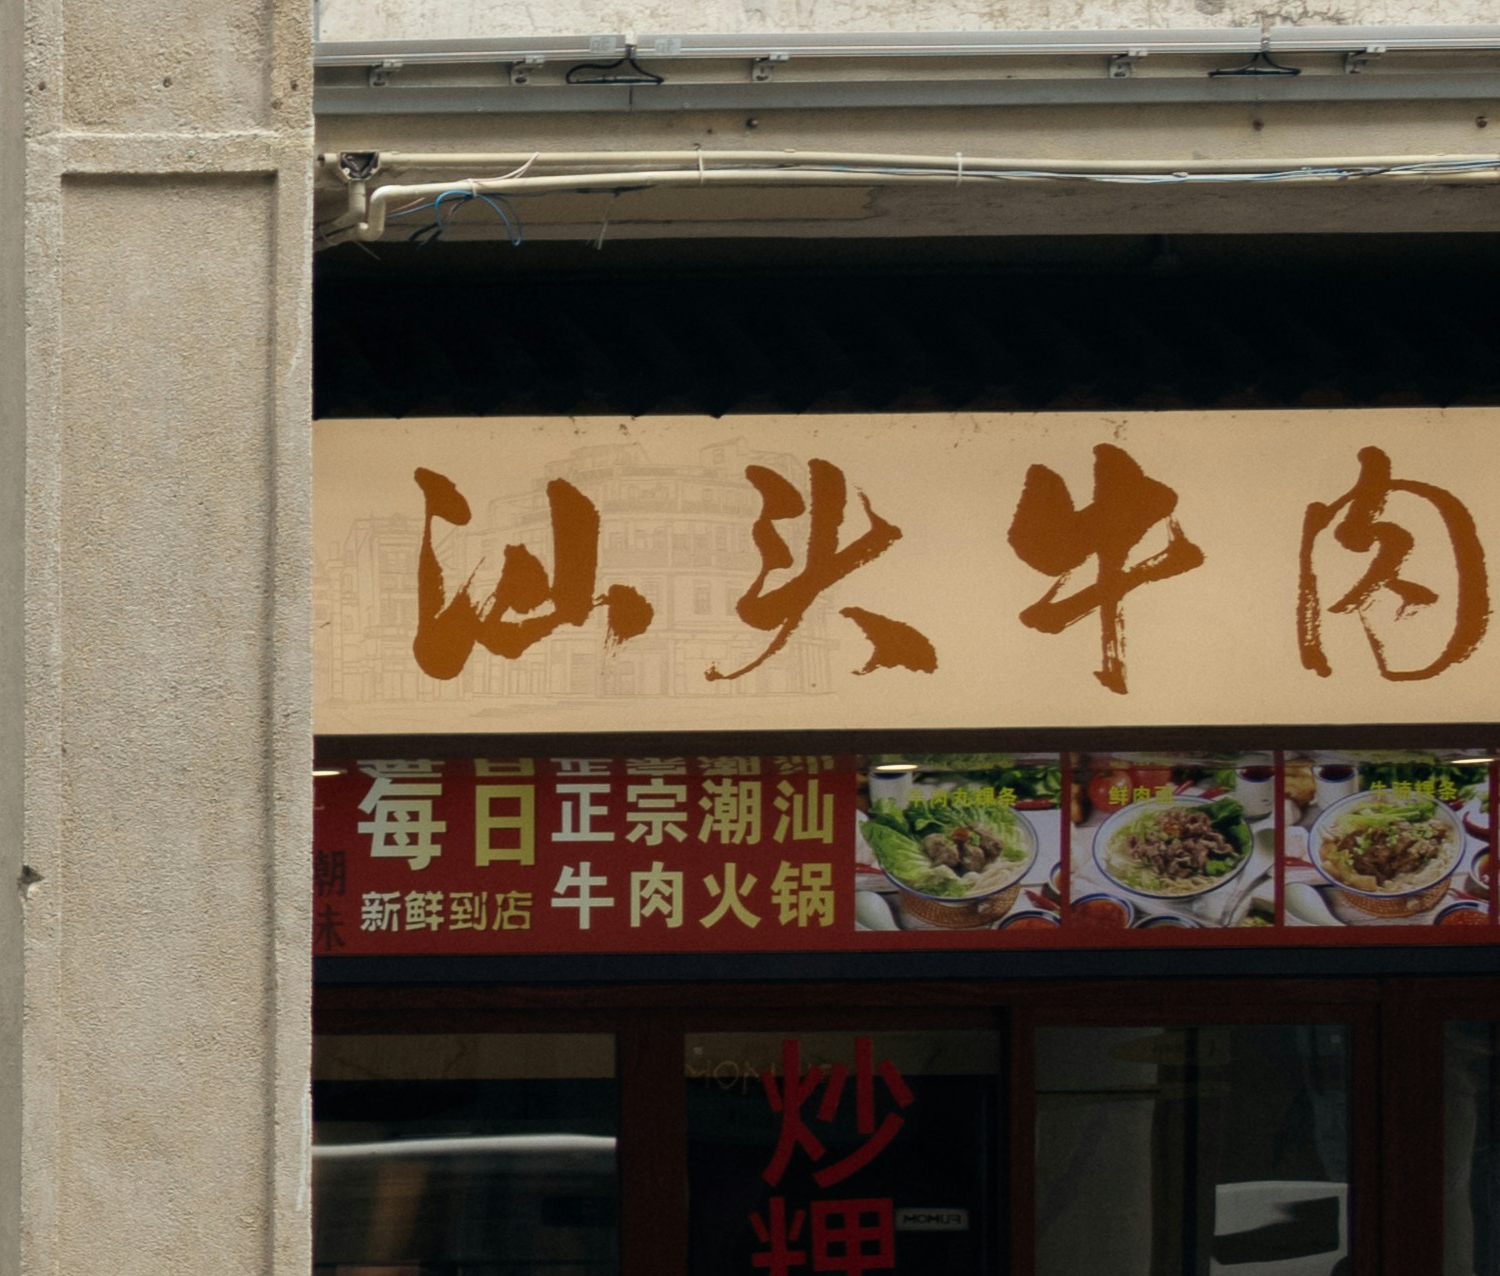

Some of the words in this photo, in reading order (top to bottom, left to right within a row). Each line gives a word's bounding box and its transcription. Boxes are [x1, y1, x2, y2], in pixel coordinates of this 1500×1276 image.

[411, 441, 1495, 697] 汕头牛肉
[356, 776, 539, 874] 每日
[550, 777, 836, 850] 正宗潮汕
[360, 889, 536, 935] 新鲜到店
[550, 860, 837, 932] 牛肉火锅
